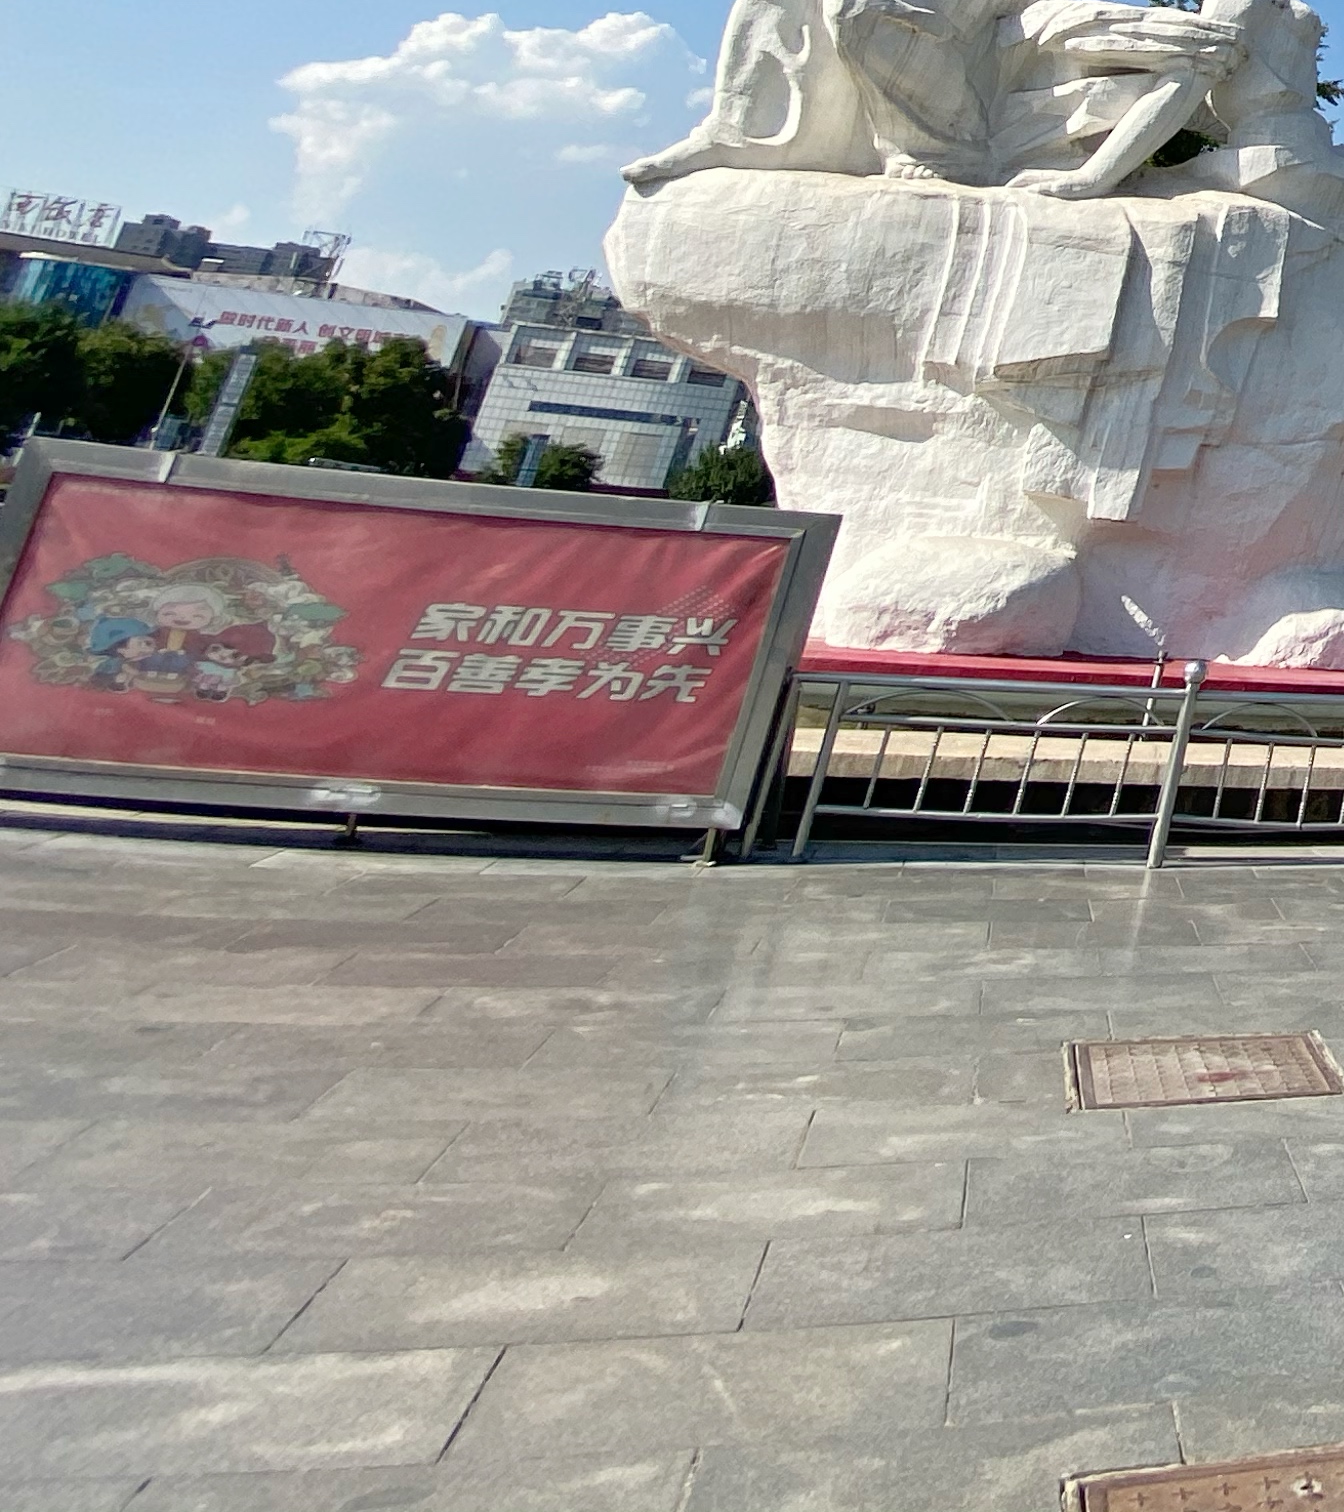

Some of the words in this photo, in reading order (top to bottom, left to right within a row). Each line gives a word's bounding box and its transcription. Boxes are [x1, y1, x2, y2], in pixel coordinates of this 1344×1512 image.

[411, 602, 738, 655] 家和万事兴
[380, 648, 712, 703] 百善孝为先
